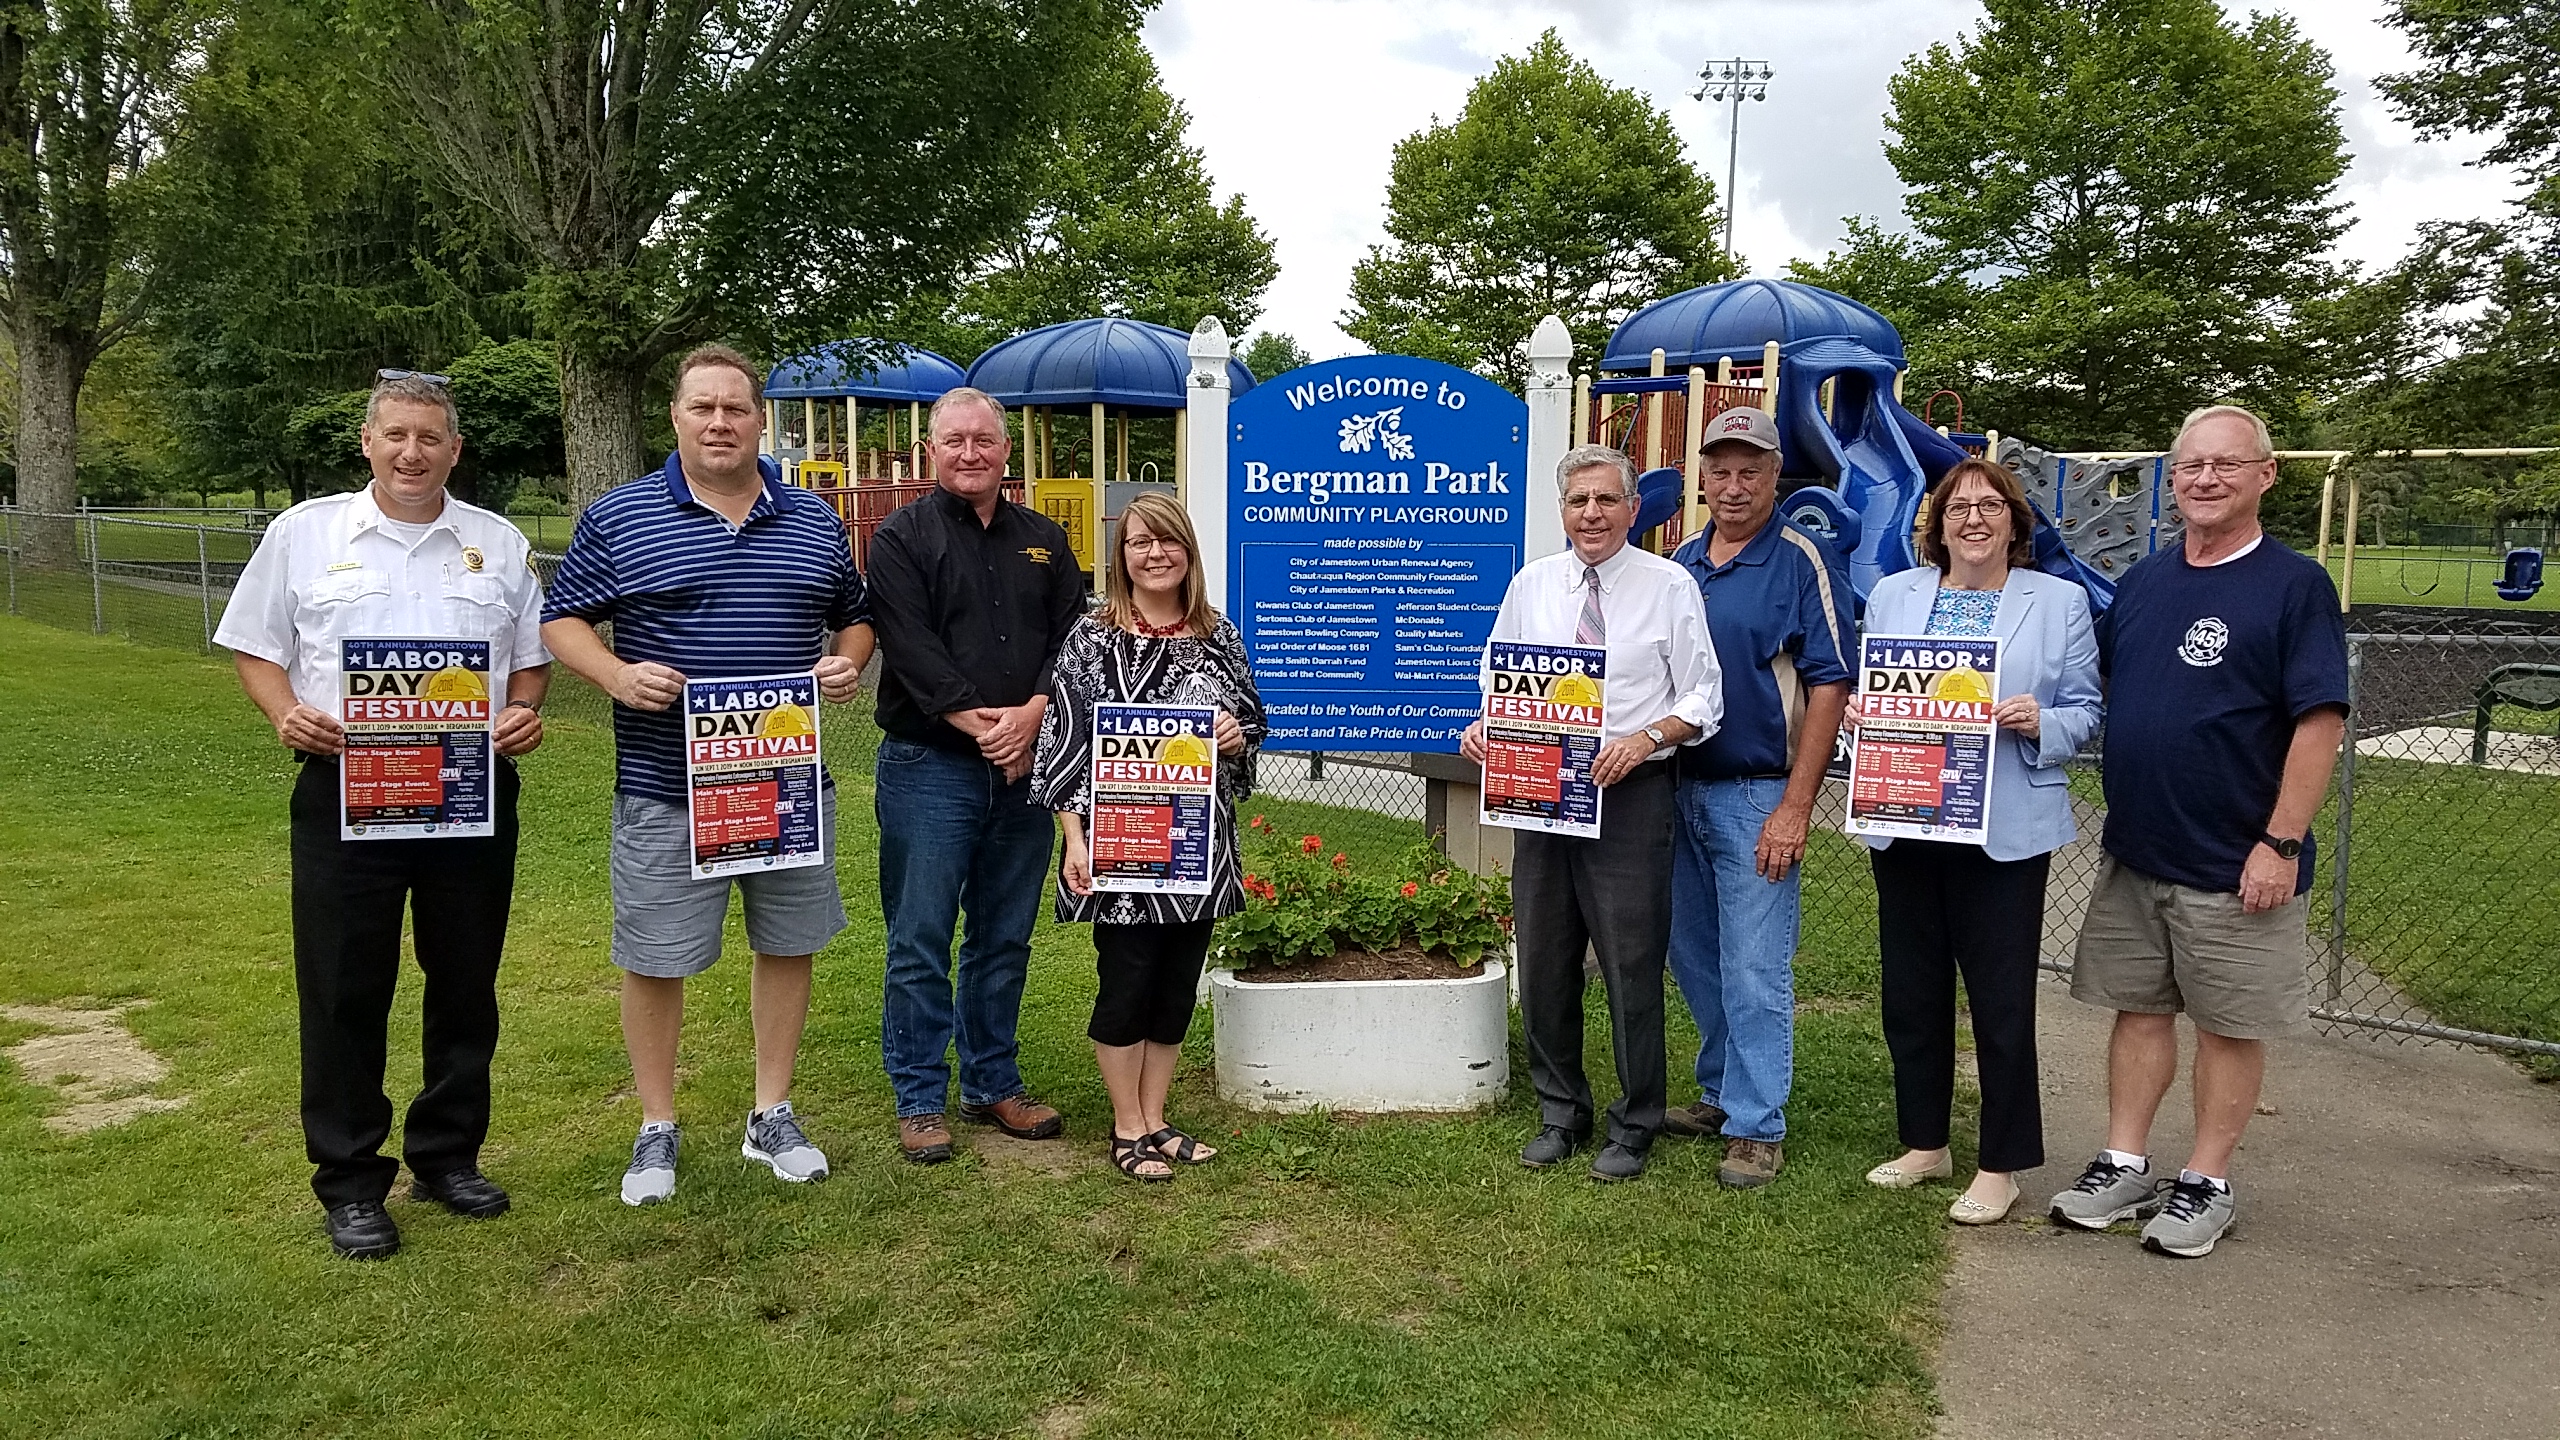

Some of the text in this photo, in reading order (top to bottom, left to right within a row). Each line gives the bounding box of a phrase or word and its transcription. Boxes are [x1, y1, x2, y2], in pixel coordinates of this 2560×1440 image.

[1286, 375, 1466, 411] Welcome to
[1243, 462, 1510, 505] Bergman Park
[1244, 506, 1508, 524] COMMUNITY PLAYGROUND
[1324, 538, 1423, 551] made possible by
[1290, 558, 1474, 568] City of Jamestown Urban Renewal Agency
[1345, 572, 1375, 581] Region
[1377, 572, 1427, 582] Community
[1428, 573, 1478, 581] Foundation
[1290, 586, 1307, 595] City
[1320, 586, 1369, 594] Jamestown
[1371, 586, 1396, 594] Parks
[1398, 586, 1405, 594] &
[1407, 586, 1454, 594] Recreation
[1324, 602, 1374, 610] Jamestown
[1437, 603, 1470, 611] Student
[1295, 615, 1315, 623] Club
[1395, 616, 1444, 624] McDonalds
[1255, 628, 1380, 638] Jamestown Bowling Company
[1395, 630, 1426, 639] Quality
[2194, 630, 2218, 648] 45
[1255, 643, 1279, 651] Loyal
[1318, 643, 1346, 651] Moose
[1423, 644, 1444, 652] Club
[1446, 644, 1485, 652] Foundati
[1495, 644, 1603, 658] 40TH ANNUAL JAMESTOWN
[1935, 641, 1994, 650] JAMESTOWN
[366, 651, 464, 669] LABOR
[1312, 657, 1342, 665] Darrah
[1395, 658, 1445, 666] Jamestown
[1447, 658, 1471, 666] Lions
[1507, 653, 1584, 674] LABOR
[1885, 649, 1974, 668] LABOR
[1255, 670, 1365, 680] Friends of the Community
[1395, 672, 1480, 680] Wal-Mart Foundatio
[350, 674, 424, 695] DAY
[719, 682, 754, 691] ANNUAL
[757, 679, 811, 689] JAMESTOWN
[1494, 673, 1552, 697] DAY
[1868, 671, 1935, 694] DAY
[709, 689, 794, 711] LABOR
[348, 700, 485, 718] FESTIVAL
[1160, 710, 1211, 718] JAMESTOWN
[1262, 703, 1480, 717] dicated to the Youth of Our Commu
[1491, 697, 1599, 724] FESTIVAL
[1865, 696, 1989, 720] FESTIVAL
[696, 713, 761, 738] DAY
[772, 715, 786, 729] 2019
[1115, 718, 1194, 735] LABOR
[1266, 726, 1462, 740] espect and Take Pride in Our Pa
[694, 734, 812, 760] FESTIVAL
[1101, 738, 1162, 758] DAY
[1506, 744, 1523, 752] Stage
[1098, 762, 1208, 782] FESTIVAL
[1489, 771, 1550, 784] Second Stage Events
[380, 781, 402, 789] Stage
[1858, 775, 1931, 786] Second Stage Events
[1115, 807, 1132, 815] Stage
[698, 815, 767, 828] Second Stage Events
[1121, 837, 1139, 845] Stage
